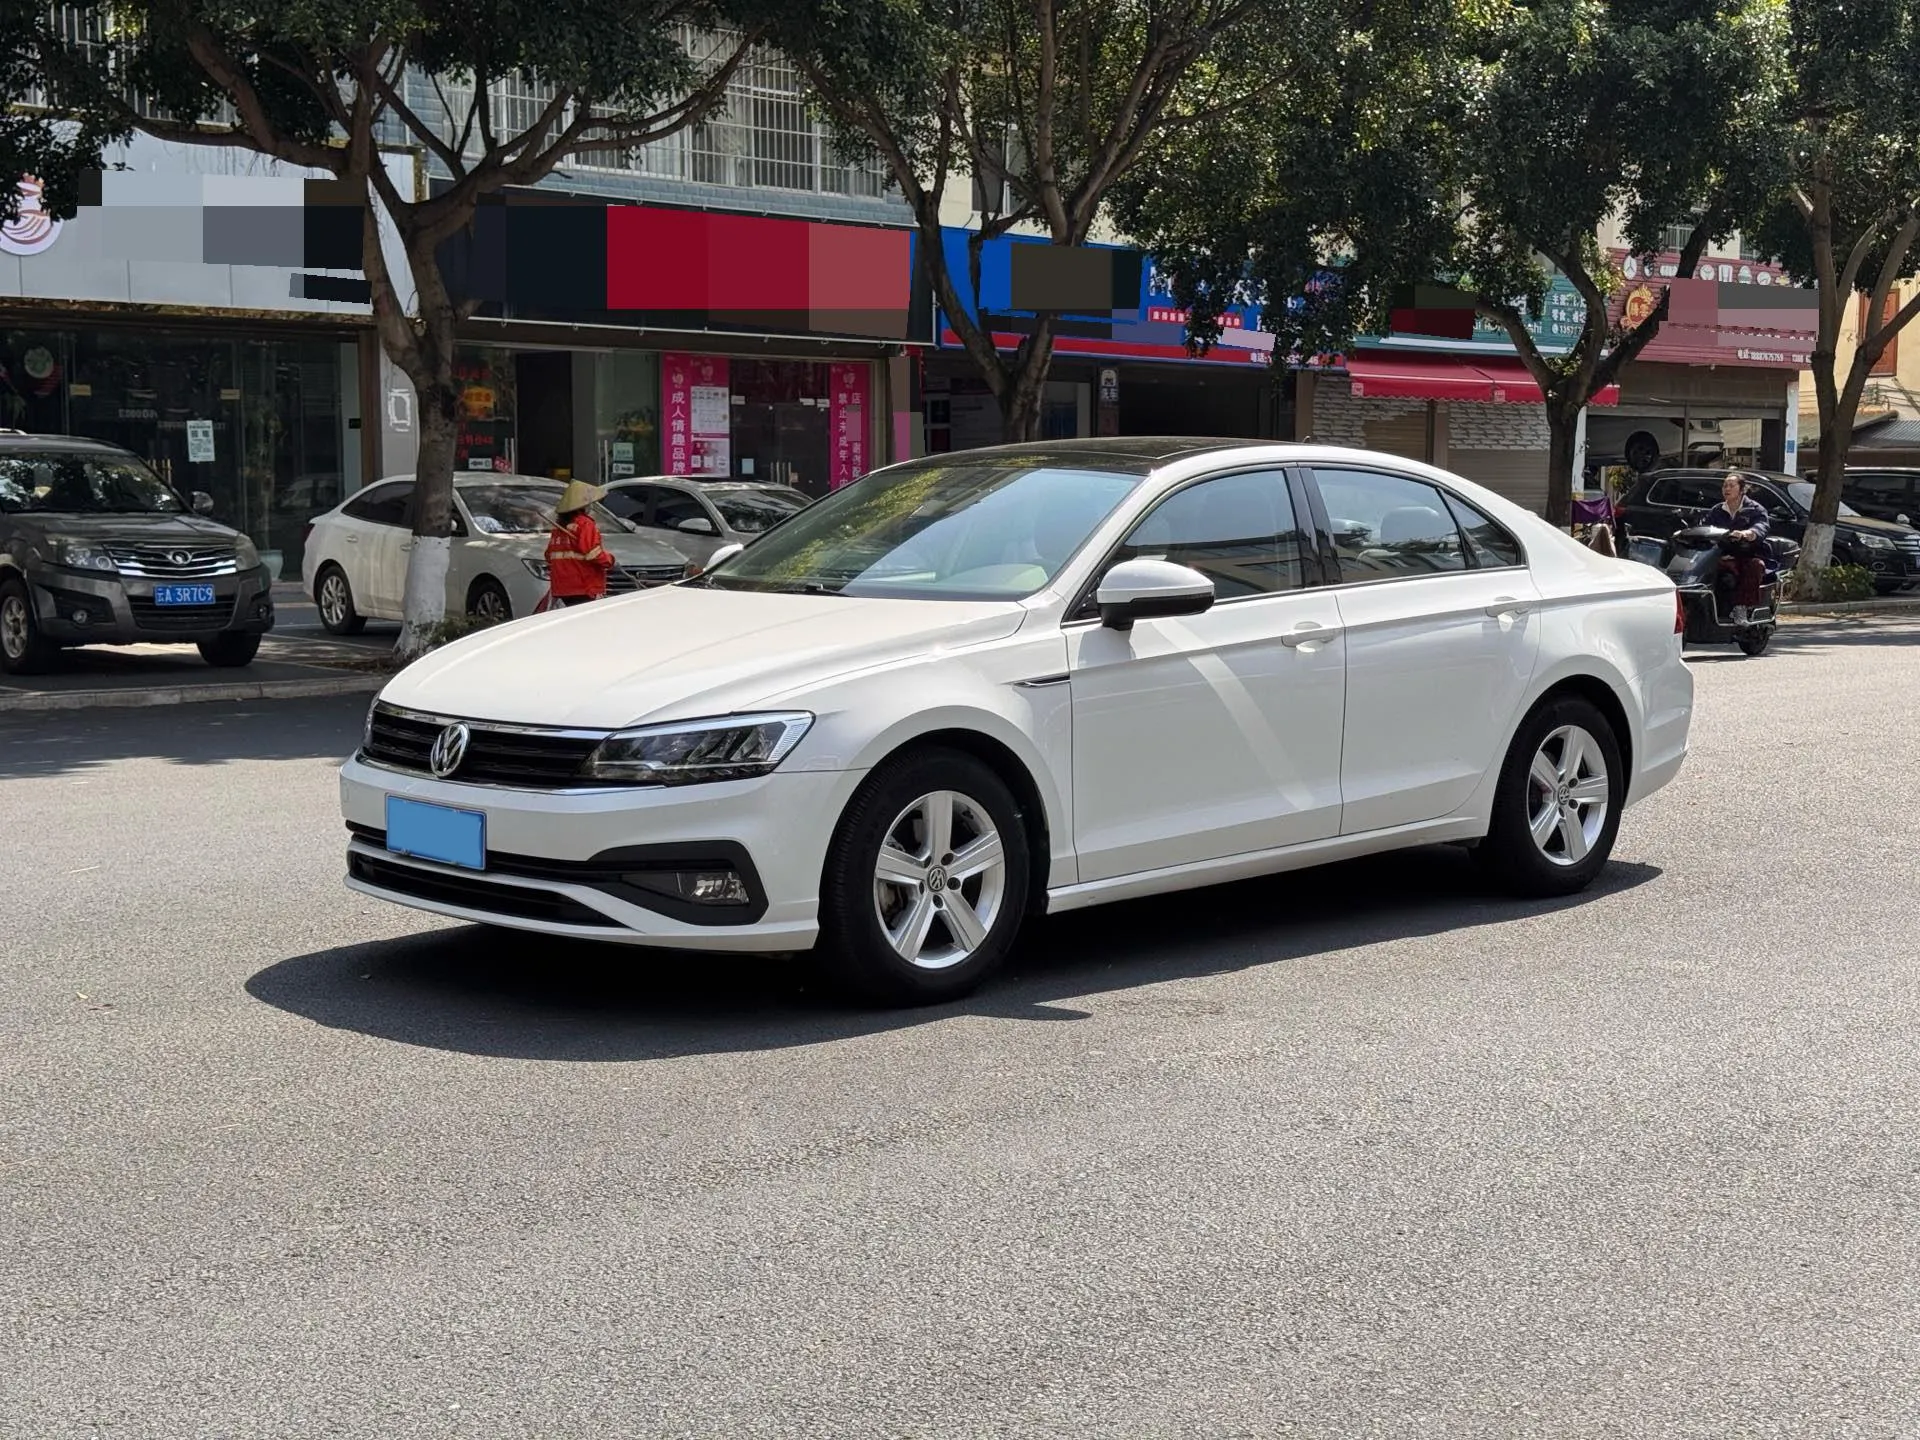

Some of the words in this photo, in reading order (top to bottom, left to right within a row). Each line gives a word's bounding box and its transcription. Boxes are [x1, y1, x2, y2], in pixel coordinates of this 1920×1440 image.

[671, 392, 686, 474] 成人情趣品牌
